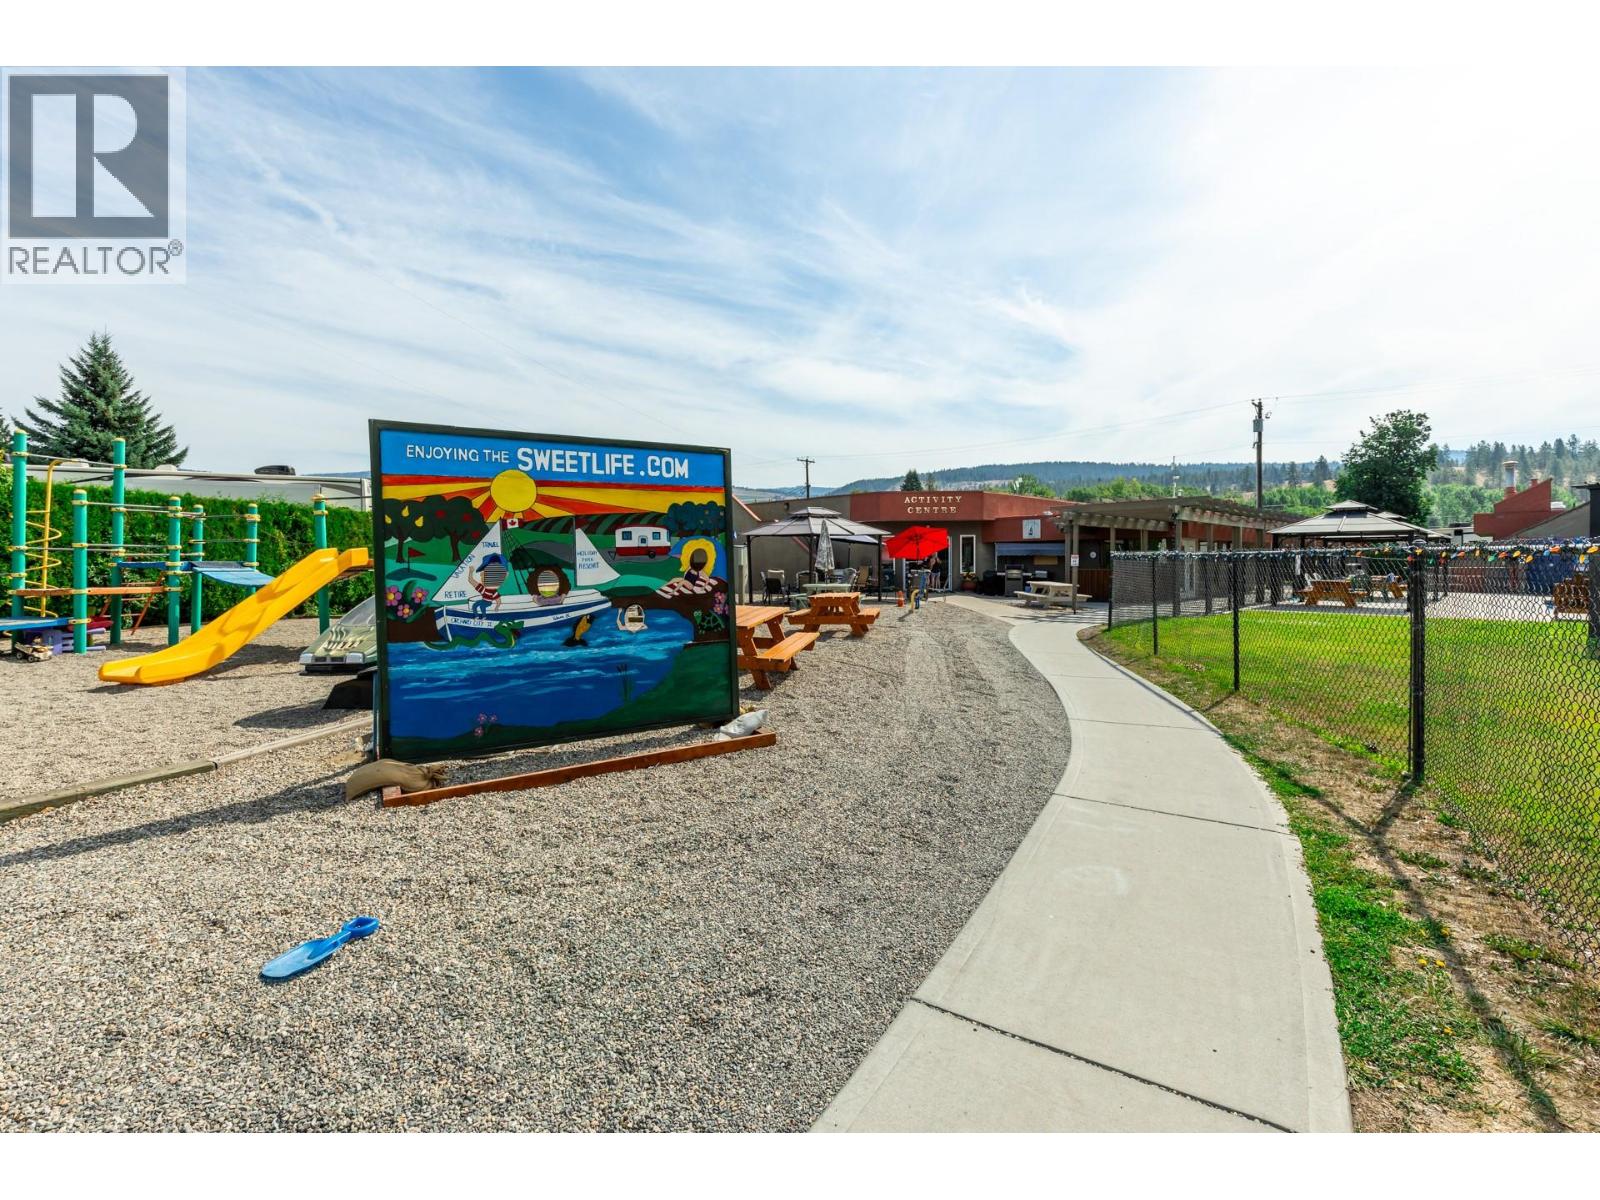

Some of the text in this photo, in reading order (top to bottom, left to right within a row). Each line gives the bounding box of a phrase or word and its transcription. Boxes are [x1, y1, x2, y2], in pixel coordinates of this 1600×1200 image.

[406, 445, 479, 463] ENJOYING
[483, 449, 510, 464] THE
[904, 495, 963, 504] ACTIVITY
[907, 506, 958, 514] CENTRE
[444, 590, 468, 599] RETIRE
